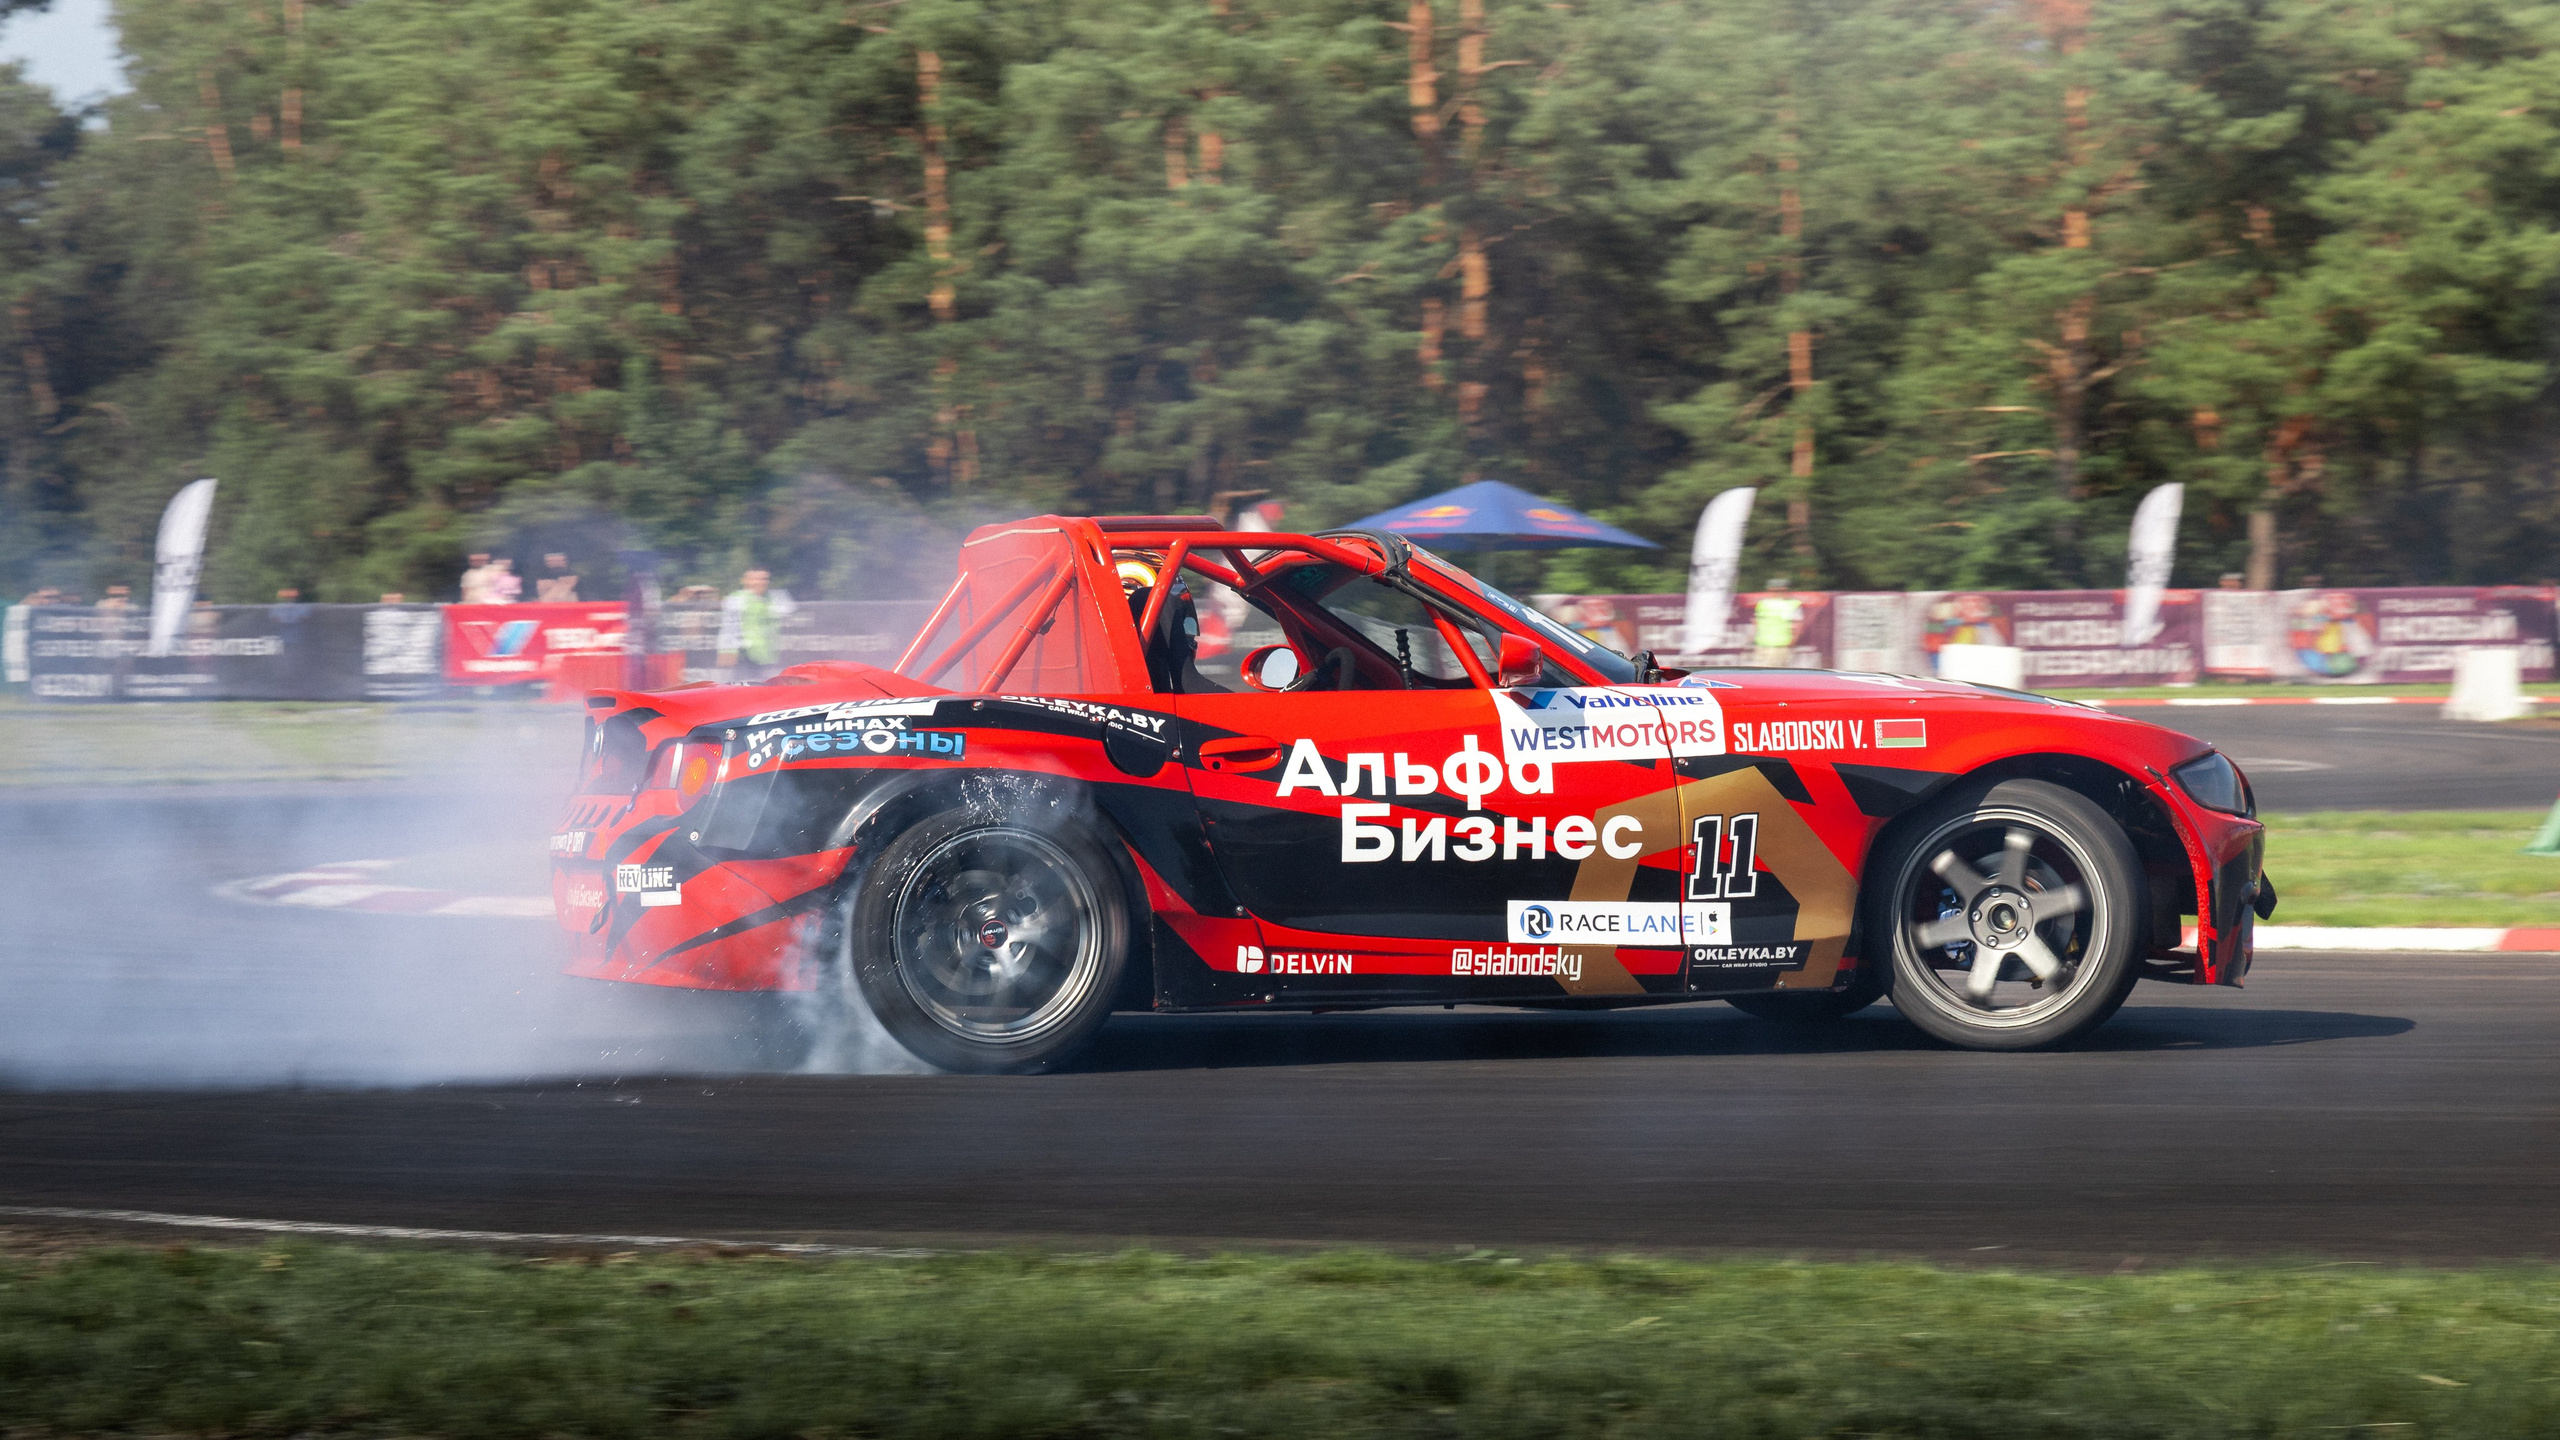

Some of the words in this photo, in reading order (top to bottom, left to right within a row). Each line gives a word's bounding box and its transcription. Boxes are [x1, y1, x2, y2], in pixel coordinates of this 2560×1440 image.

[1000, 695, 1165, 733] OKLEYKA.BY
[1048, 705, 1066, 713] CAR
[1564, 694, 1705, 708] Valvoline
[748, 728, 786, 750] НА
[796, 717, 906, 734] ШИНАХ
[1510, 719, 1717, 751] WESTMOTORS
[1733, 720, 1844, 752] SLABODSKI
[1849, 720, 1868, 748] V.
[1276, 734, 1554, 811] Альфа
[1341, 803, 1643, 862] Бизнес
[1688, 813, 1759, 899] 11
[1560, 914, 1620, 932] RACE
[1627, 914, 1695, 932] LANE
[1452, 946, 1583, 981] @slabodsky
[1694, 947, 1798, 961] OKLEYKA.BY
